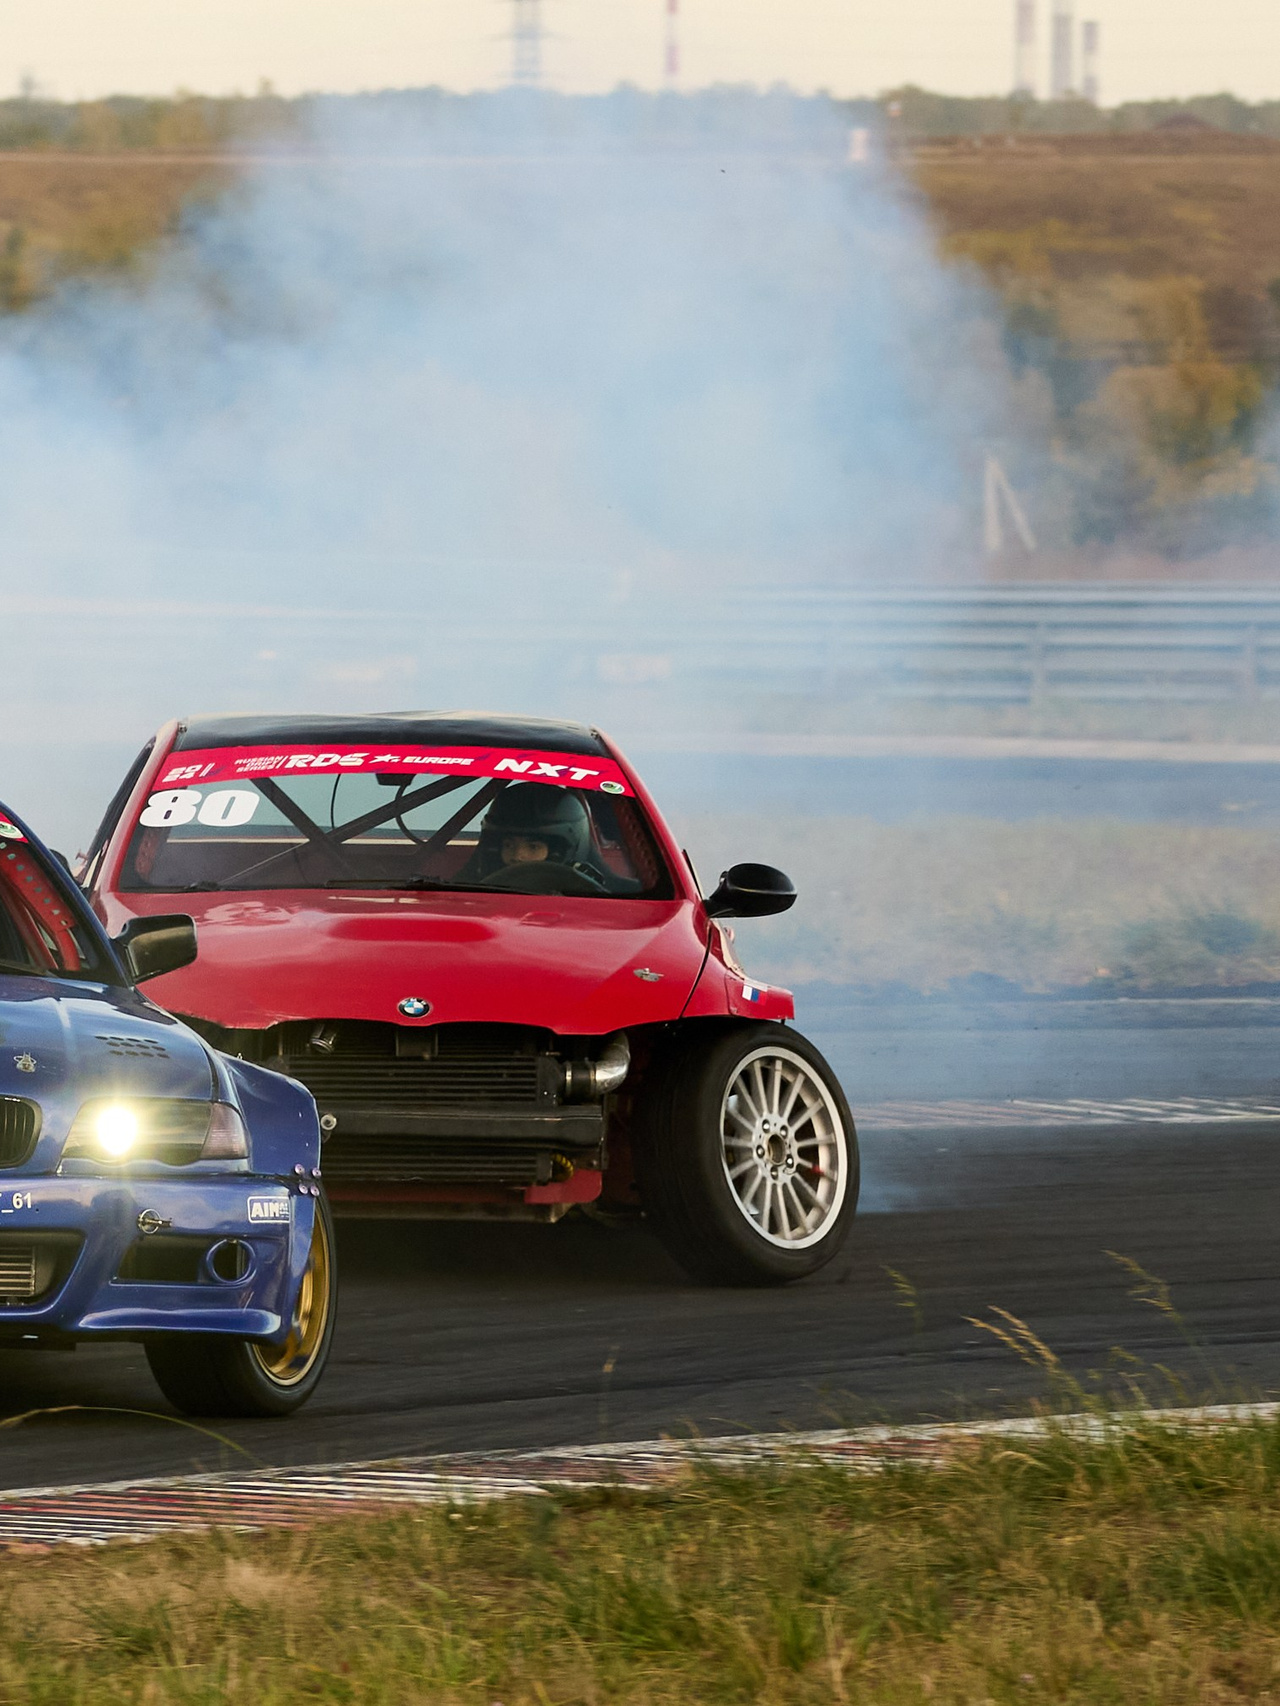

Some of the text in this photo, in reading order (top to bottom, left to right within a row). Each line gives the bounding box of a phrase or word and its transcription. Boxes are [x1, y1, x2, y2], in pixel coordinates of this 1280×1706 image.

[285, 753, 599, 781] RDS EUROPE NXT
[139, 789, 260, 828] 80
